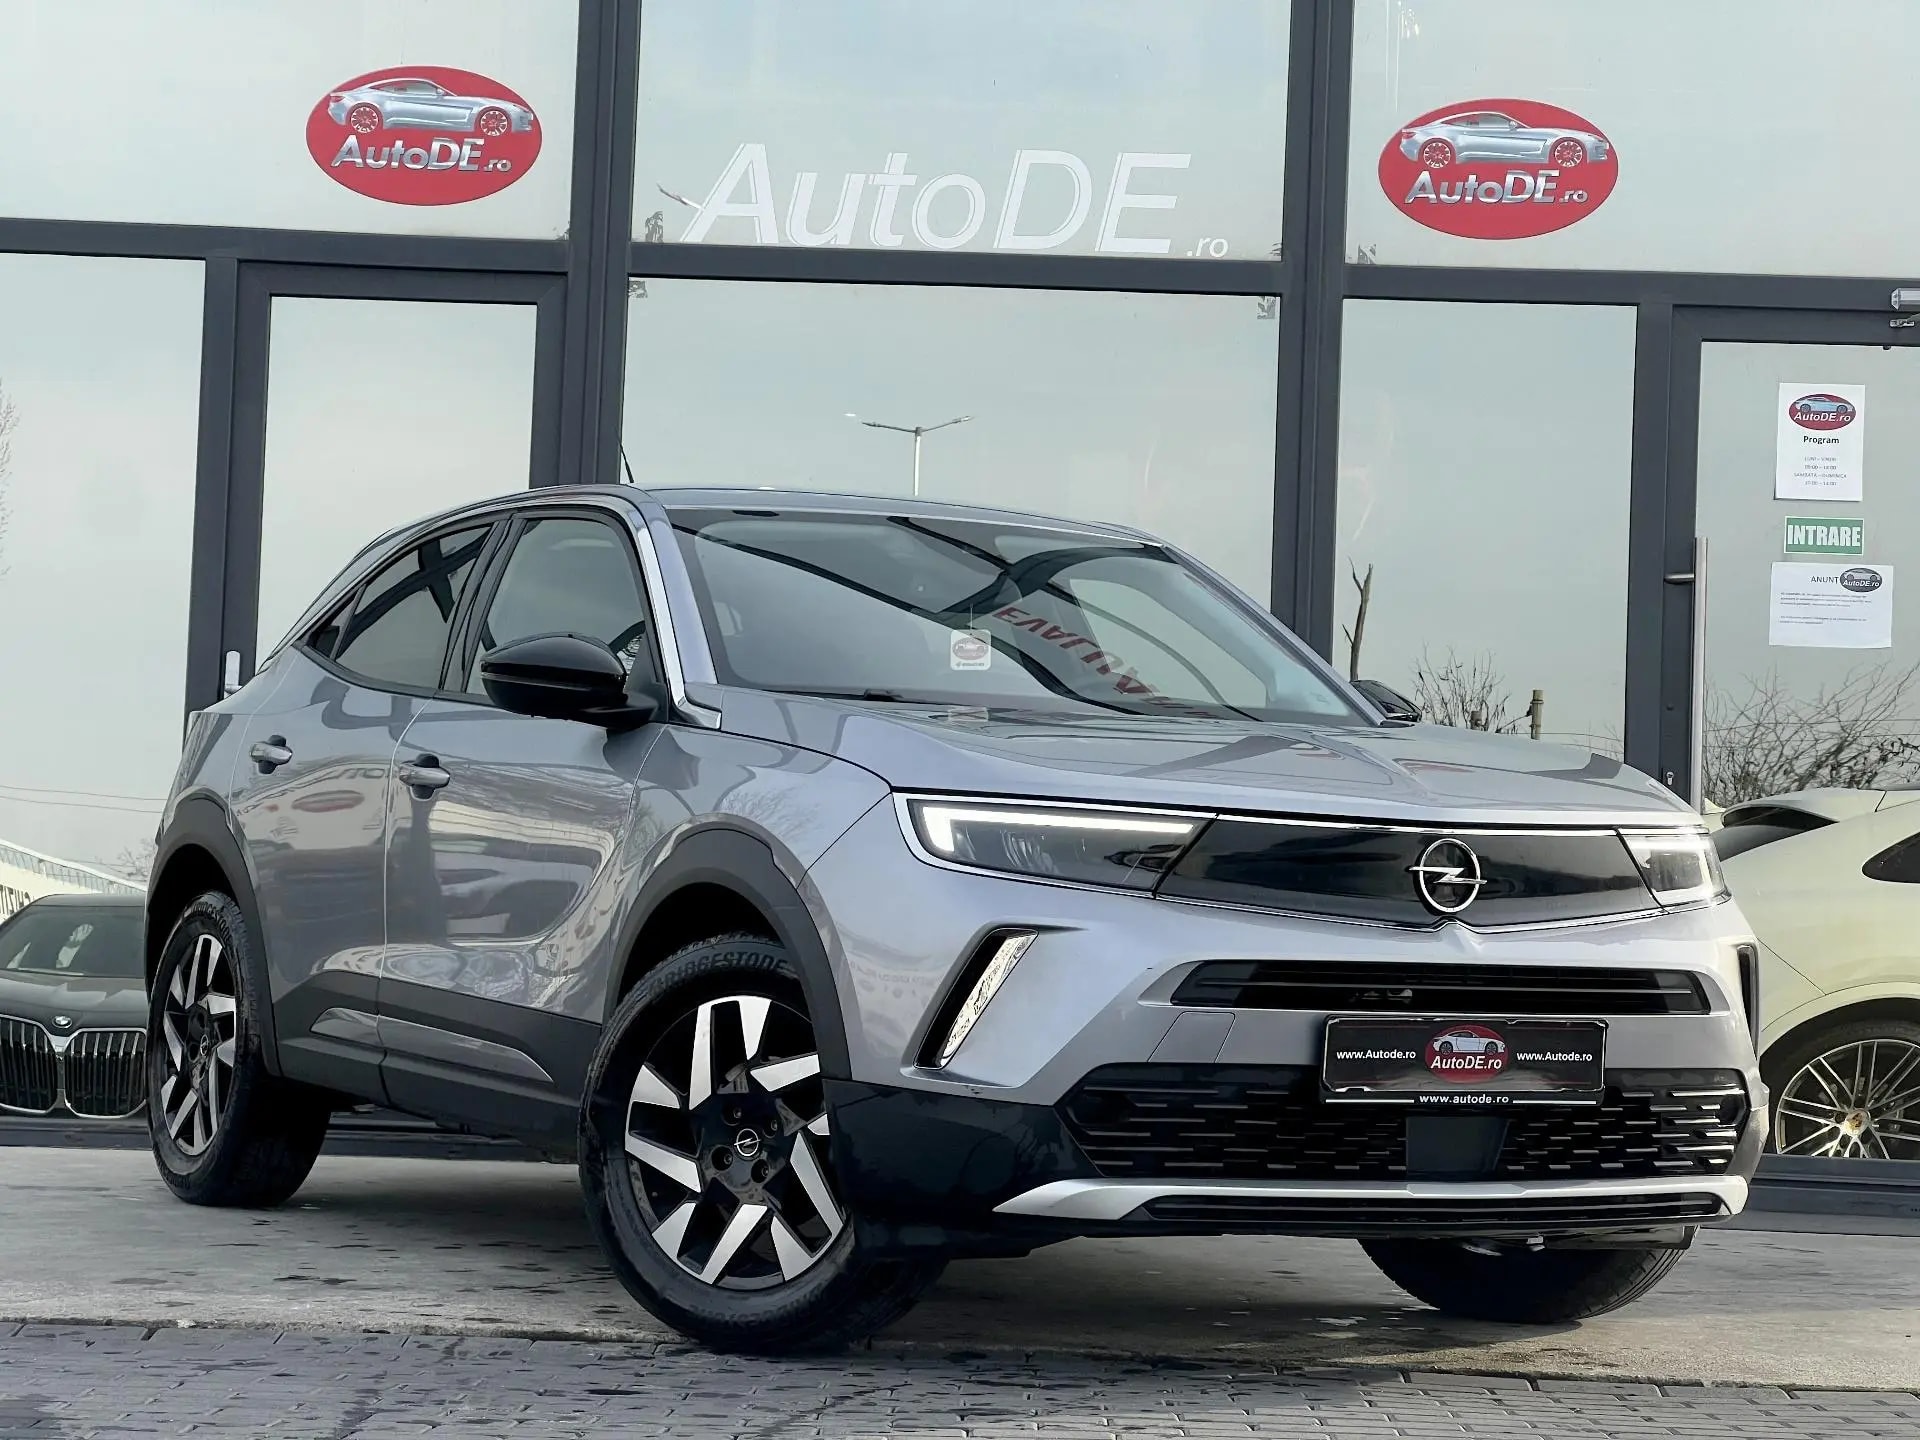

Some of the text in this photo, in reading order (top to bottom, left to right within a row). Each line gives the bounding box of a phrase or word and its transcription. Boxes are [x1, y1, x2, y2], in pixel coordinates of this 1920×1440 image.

[330, 134, 512, 172] AutoDE.ro
[1404, 169, 1589, 205] AutoDE.ro
[1793, 412, 1851, 422] AutoDE.ro
[1803, 435, 1840, 445] Program
[1787, 524, 1861, 547] INTRARE
[1842, 578, 1880, 588] AutoDE.ro
[1336, 1048, 1593, 1070] www.Autode.ro AutoDE.ro www.Autode.ro
[1419, 1093, 1510, 1105] www.autode.ro
